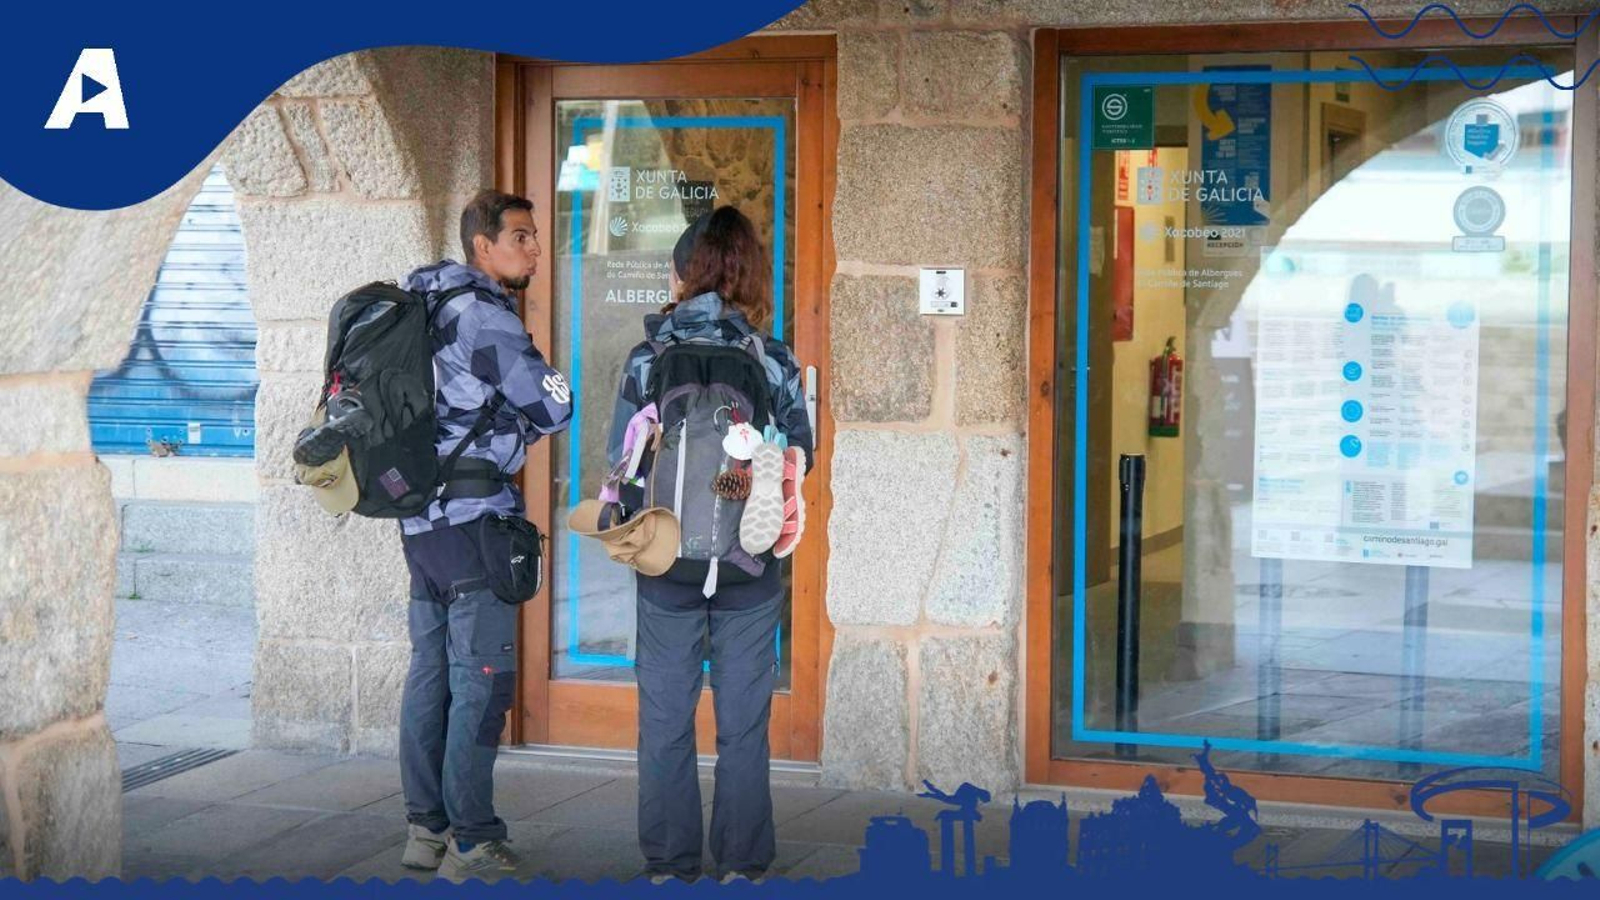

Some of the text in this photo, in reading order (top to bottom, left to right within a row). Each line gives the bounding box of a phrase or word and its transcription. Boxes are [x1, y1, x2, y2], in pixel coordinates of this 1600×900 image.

[635, 169, 687, 182] XUNTA
[1170, 170, 1229, 185] XUNTA
[635, 186, 720, 200] DE GALICIA
[1170, 187, 1265, 202] DE GALICIA
[1164, 226, 1246, 238] Xacobeo 2021
[626, 260, 652, 269] Pública
[1201, 269, 1243, 279] Albergues
[1193, 279, 1229, 289] Santiago
